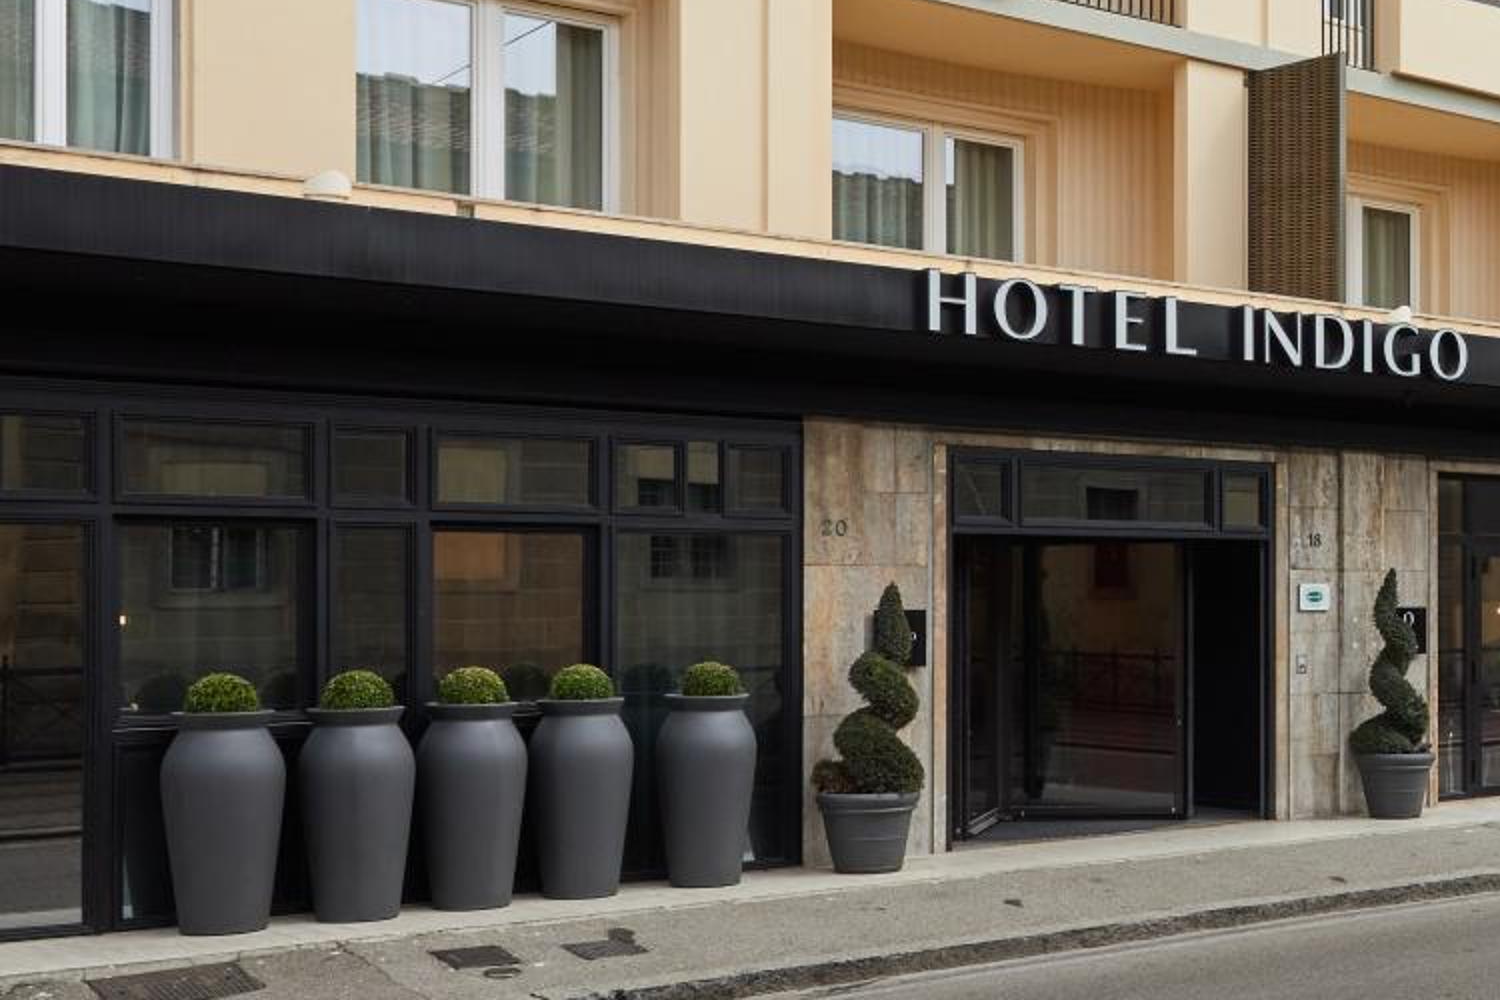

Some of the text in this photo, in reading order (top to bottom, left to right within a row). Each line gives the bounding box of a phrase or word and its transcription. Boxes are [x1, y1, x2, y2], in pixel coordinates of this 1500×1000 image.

[926, 268, 1468, 381] HOTEL INDIGO
[821, 519, 848, 537] 20
[1307, 533, 1322, 548] 18
